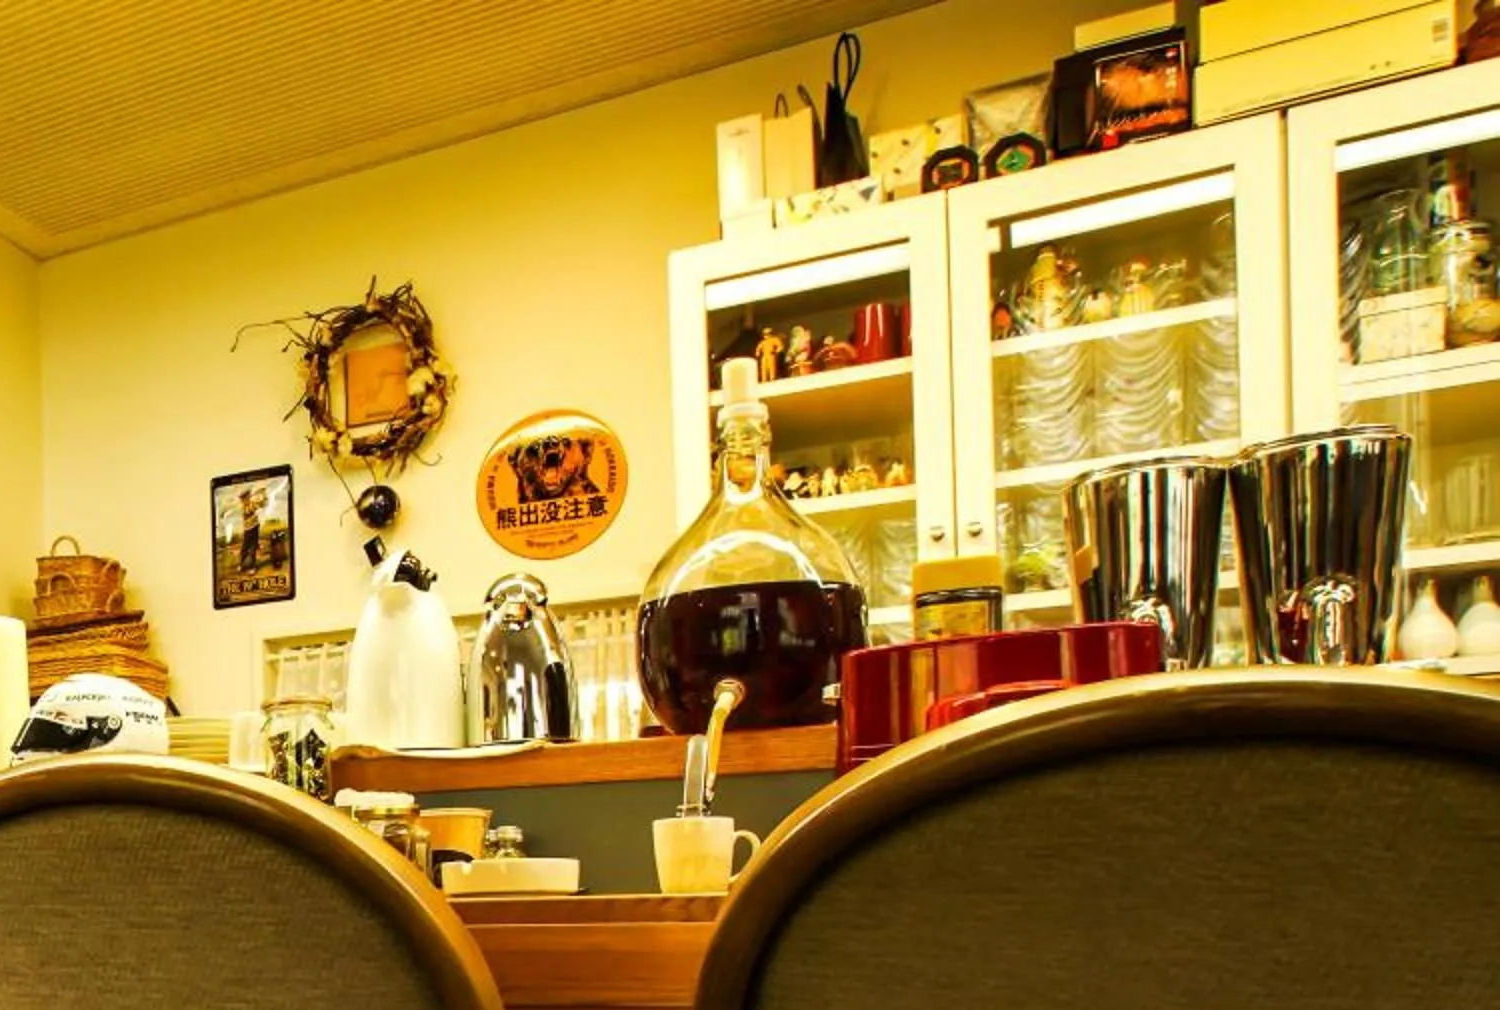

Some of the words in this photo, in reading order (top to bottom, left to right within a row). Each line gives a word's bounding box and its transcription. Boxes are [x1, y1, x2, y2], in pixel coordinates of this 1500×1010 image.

[497, 496, 609, 530] 熊出没注意
